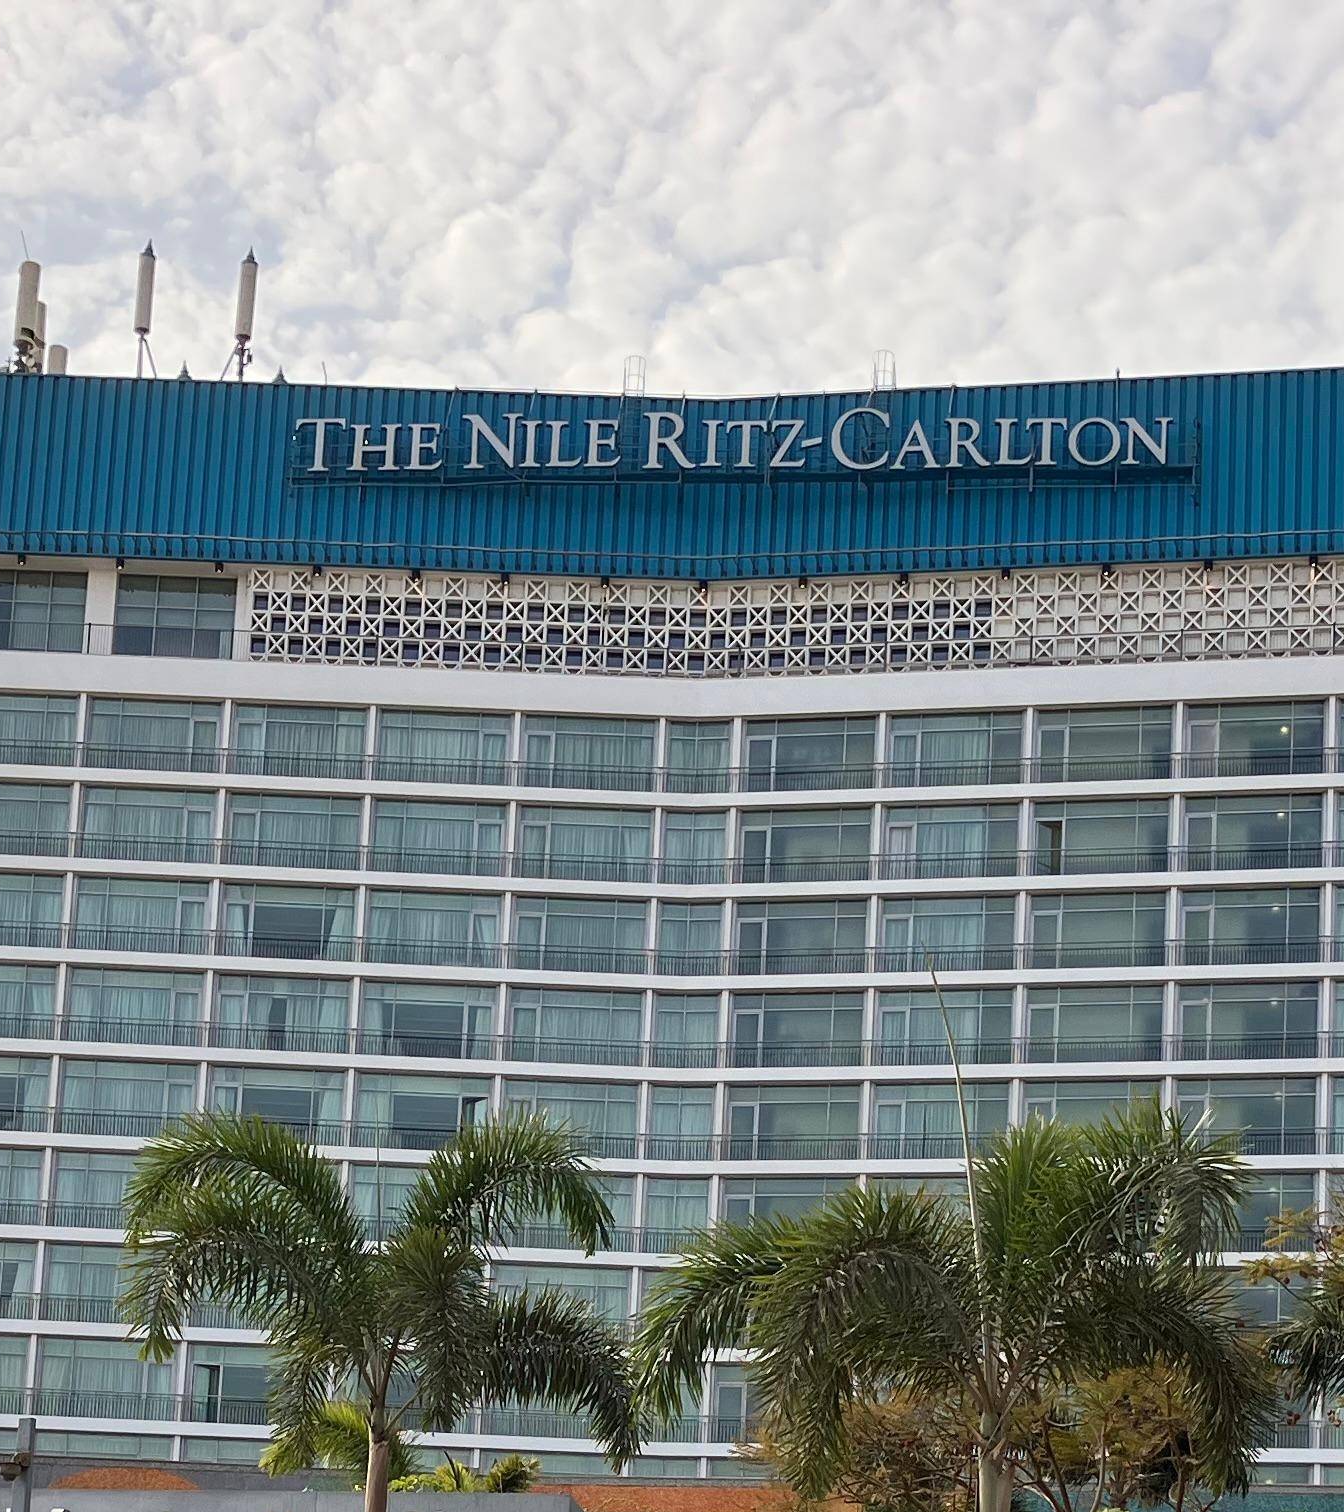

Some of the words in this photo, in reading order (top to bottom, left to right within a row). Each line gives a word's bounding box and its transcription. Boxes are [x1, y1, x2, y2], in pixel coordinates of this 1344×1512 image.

[295, 417, 443, 473] THE
[462, 412, 622, 469] NILE
[641, 406, 1174, 471] RITZ-CARLTON
